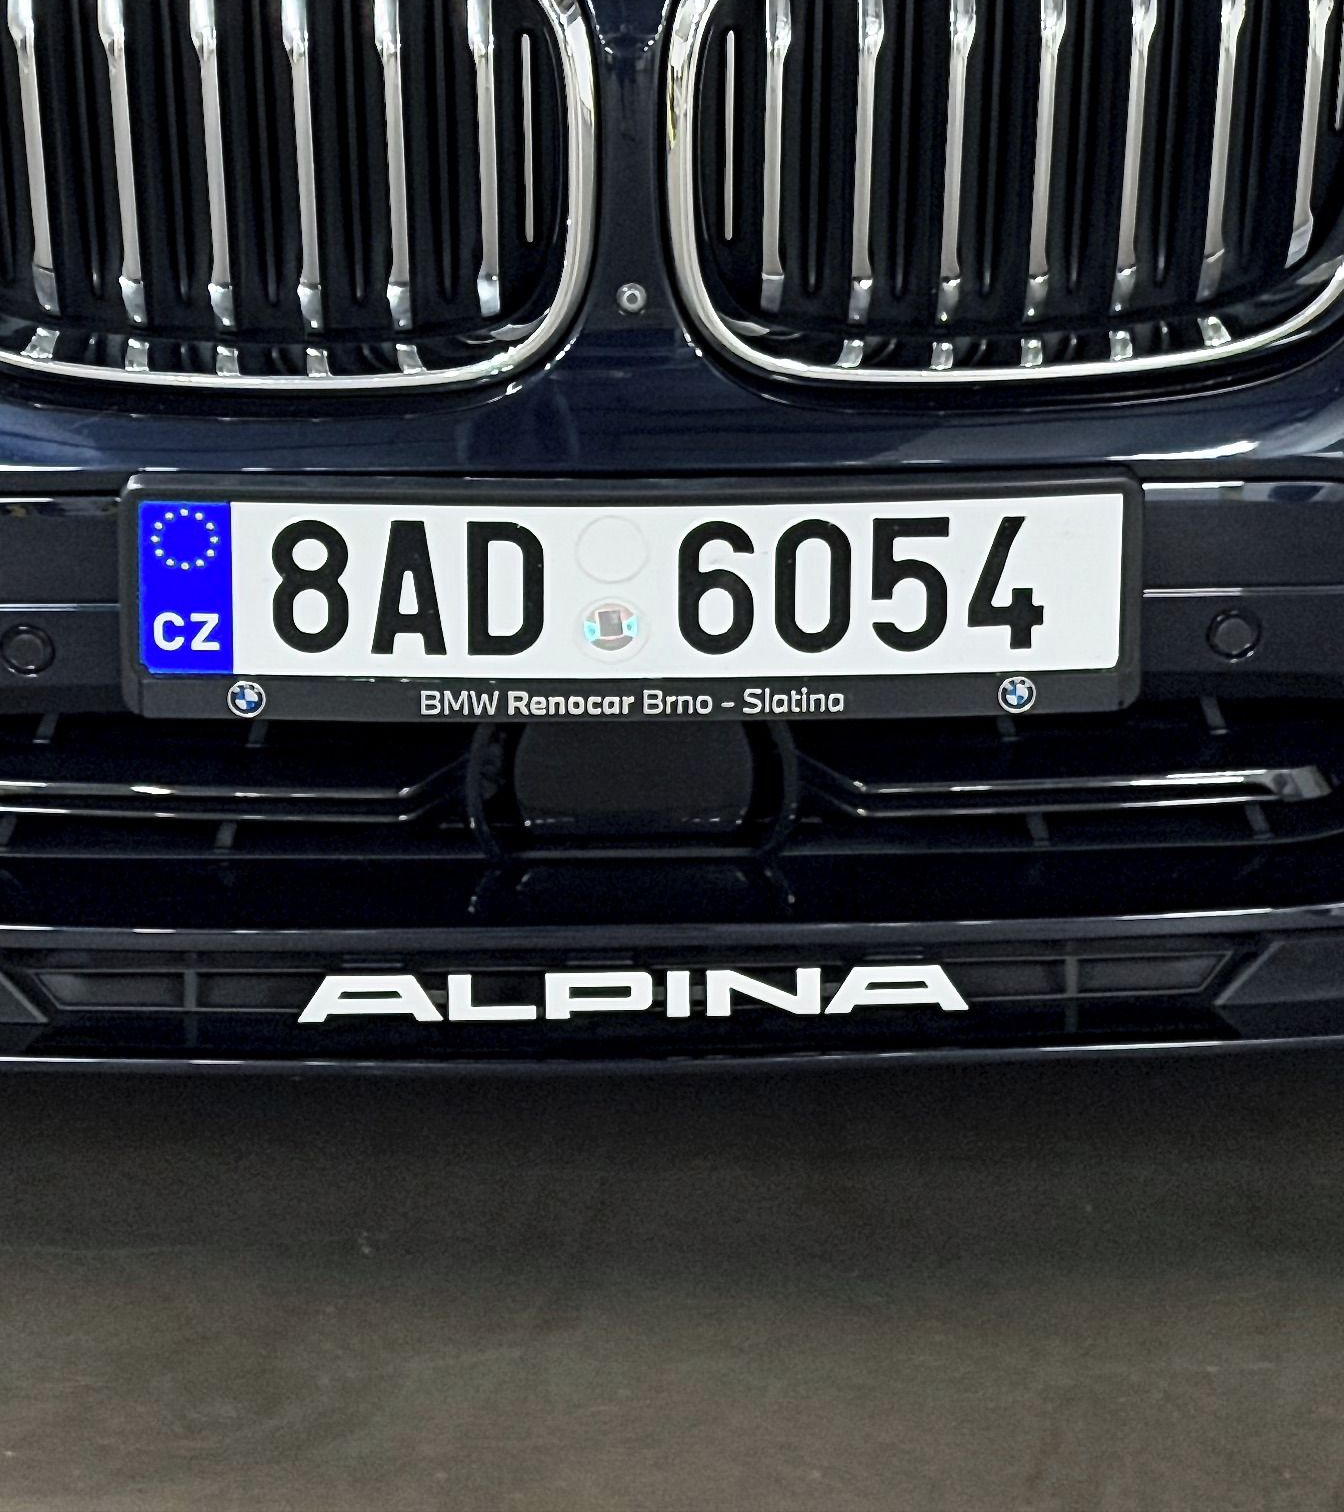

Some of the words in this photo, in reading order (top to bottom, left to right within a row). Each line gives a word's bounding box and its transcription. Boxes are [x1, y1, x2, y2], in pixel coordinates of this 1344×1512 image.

[272, 520, 544, 655] 8AD
[679, 517, 1044, 654] 6054
[153, 612, 221, 651] CZ
[420, 690, 500, 716] BMW
[508, 690, 635, 716] Renocar
[642, 689, 713, 715] Brno
[743, 686, 845, 714] Slatina
[298, 965, 969, 1022] ALPINA
